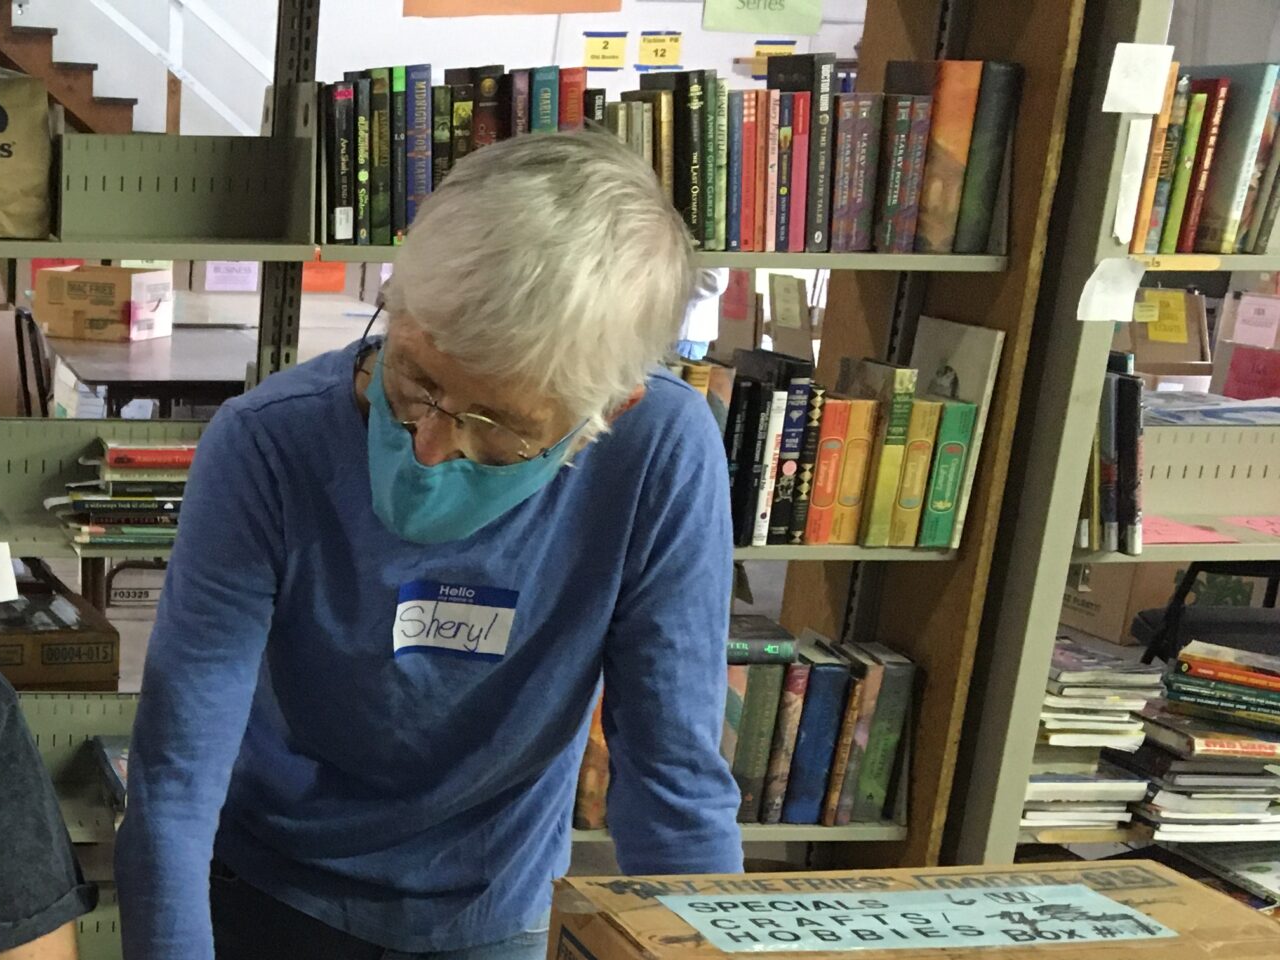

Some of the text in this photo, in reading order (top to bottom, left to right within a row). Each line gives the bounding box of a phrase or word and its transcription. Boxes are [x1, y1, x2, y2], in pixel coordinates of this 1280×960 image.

[602, 41, 609, 50] 2
[653, 49, 666, 58] 12
[820, 64, 829, 93] DOCTOR
[414, 79, 426, 130] MIDNIGHT
[540, 87, 551, 125] CHARLIE
[595, 94, 603, 121] COLLINS
[820, 94, 828, 112] WHO
[691, 164, 699, 184] LAST
[892, 134, 906, 205] HARRY POTTER
[856, 173, 865, 203] POTTER
[690, 185, 700, 224] OLYMPIAN
[91, 282, 116, 297] FRIES
[935, 464, 951, 492] Library
[113, 590, 150, 600] #03325
[439, 584, 476, 599] Hello
[398, 601, 499, 654] Sheryl
[687, 898, 890, 914] SPECIALS
[725, 925, 989, 944] HOBBIES
